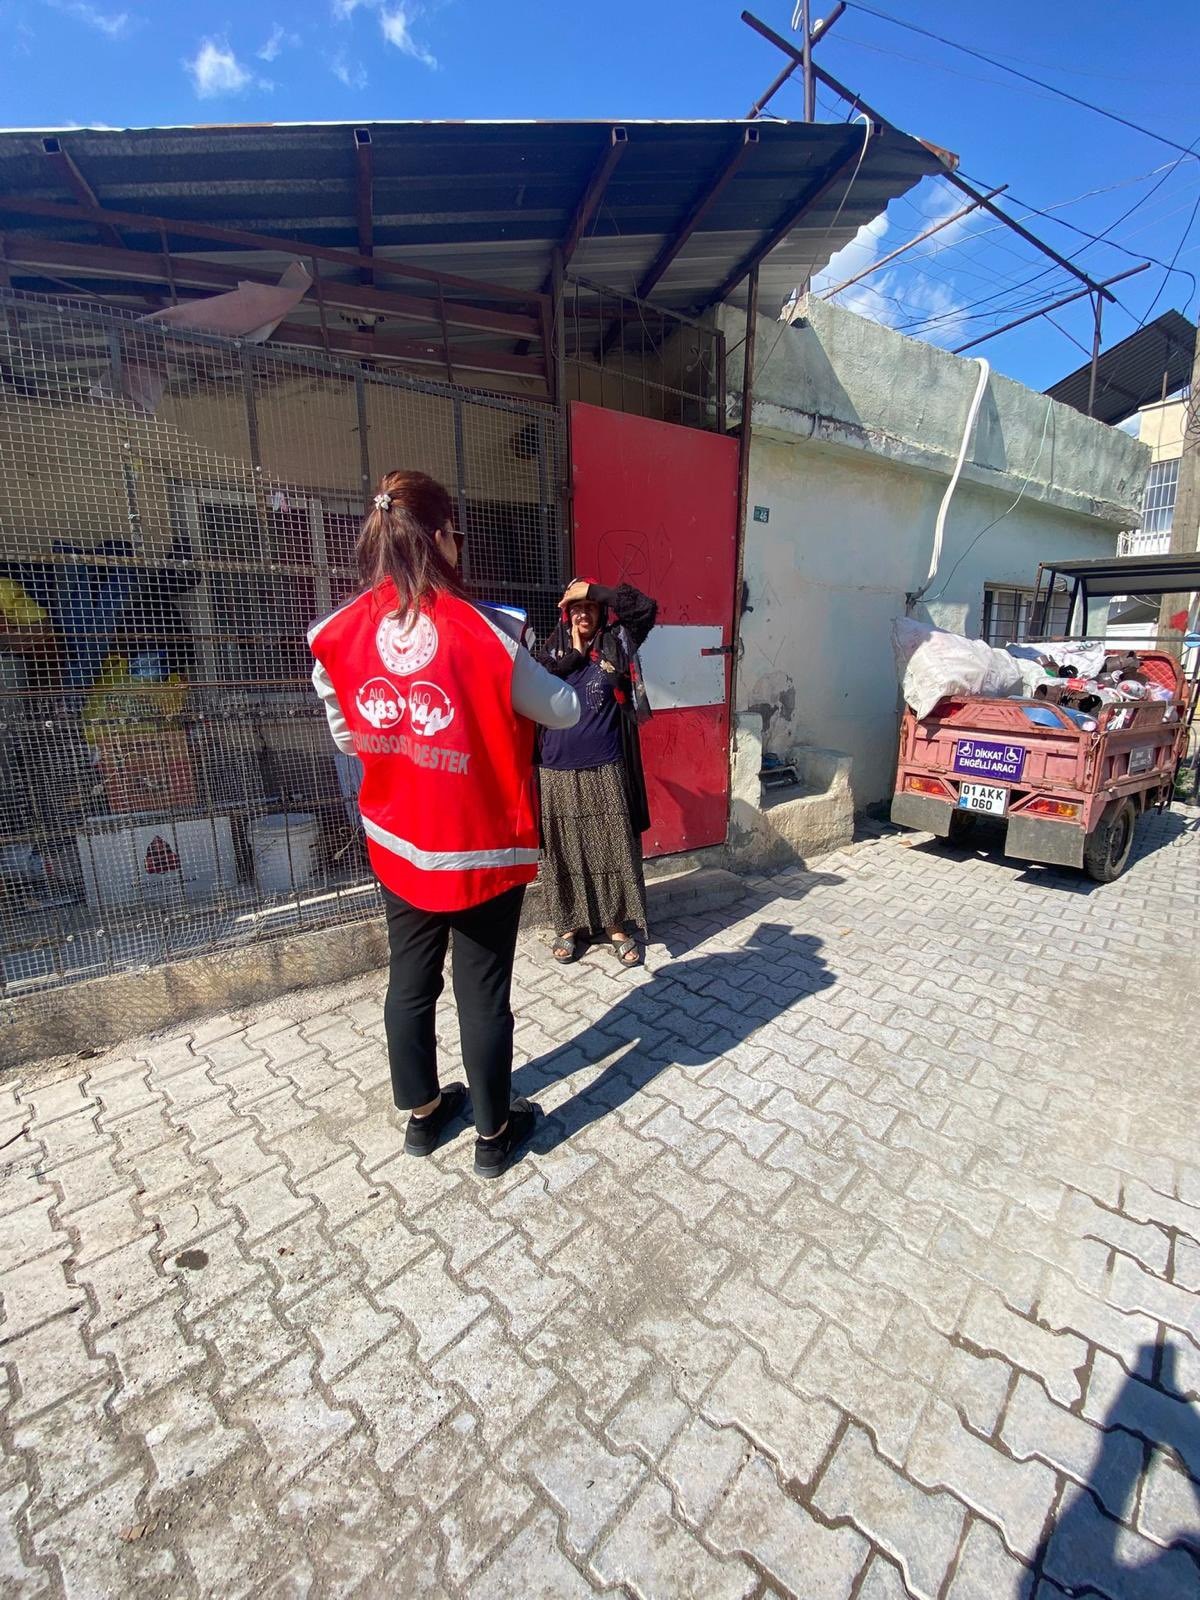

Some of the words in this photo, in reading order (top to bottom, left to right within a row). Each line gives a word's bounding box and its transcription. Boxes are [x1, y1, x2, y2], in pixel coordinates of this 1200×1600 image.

[369, 688, 385, 700] ALO
[412, 692, 431, 706] ALO
[365, 700, 399, 720] 183
[414, 743, 471, 775] DESTEK
[975, 748, 1003, 760] DİKKAT
[991, 763, 1016, 774] ARACI
[963, 785, 976, 796] 01
[979, 788, 1004, 800] AKK
[972, 798, 992, 810] 060
